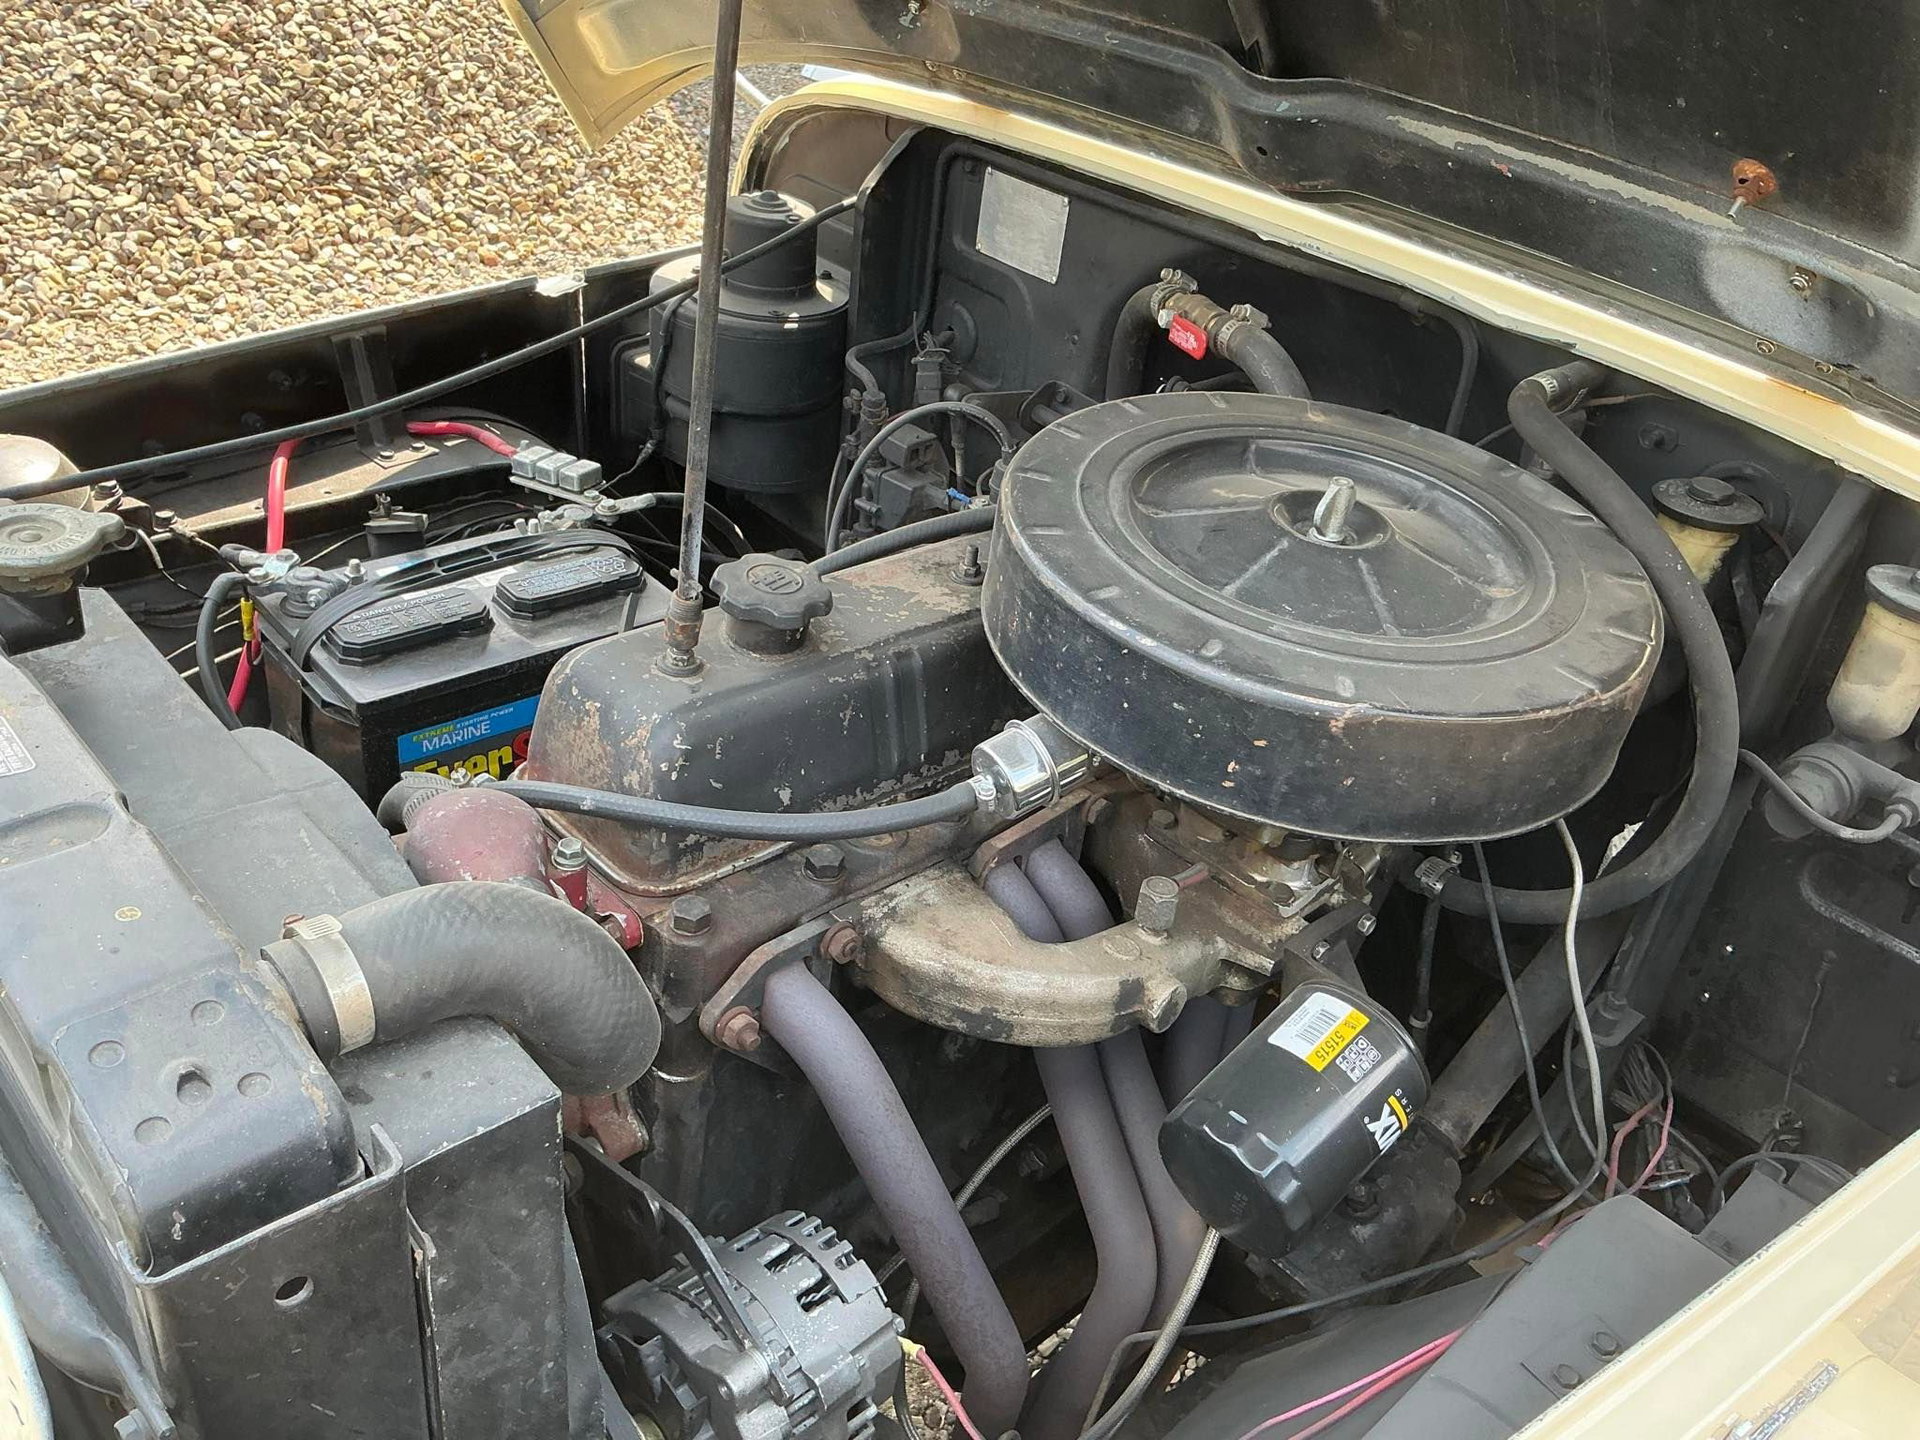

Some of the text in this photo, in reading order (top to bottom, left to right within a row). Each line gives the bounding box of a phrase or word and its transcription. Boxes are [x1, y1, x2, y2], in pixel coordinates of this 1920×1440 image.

[413, 724, 456, 742] EXTREME
[490, 706, 514, 718] POWER
[422, 720, 491, 753] MARINE
[1315, 1030, 1345, 1062] 51515
